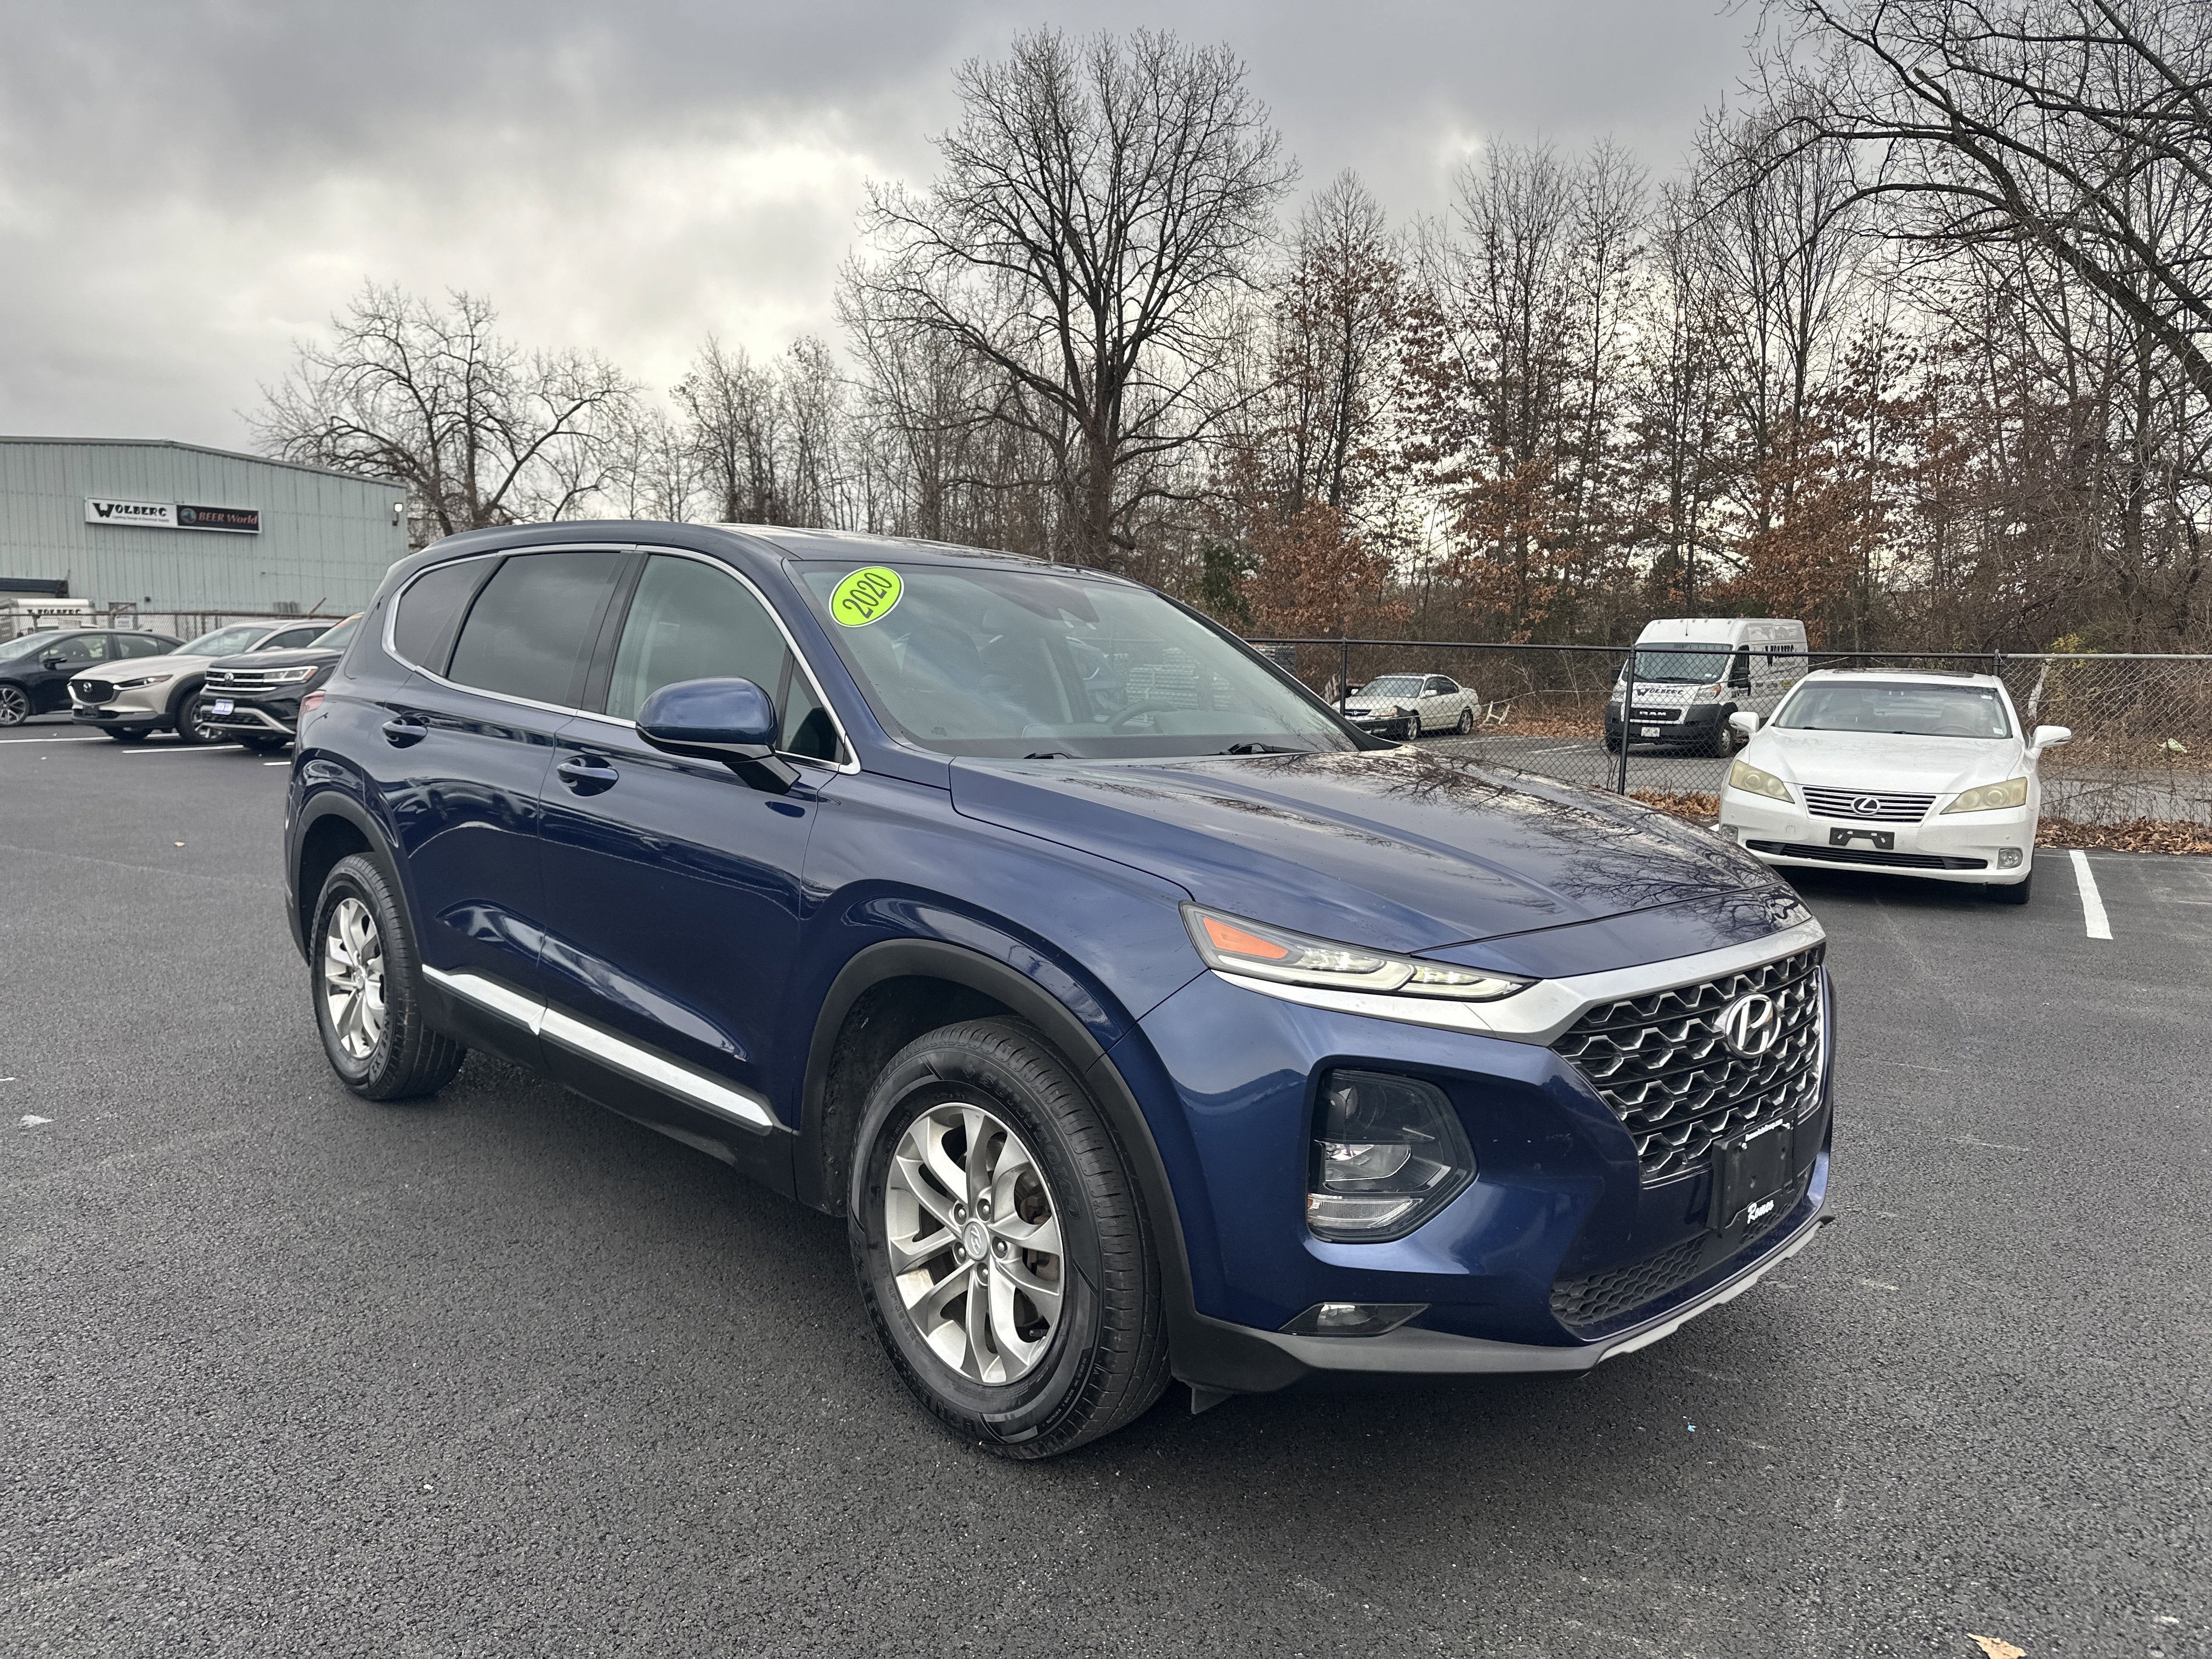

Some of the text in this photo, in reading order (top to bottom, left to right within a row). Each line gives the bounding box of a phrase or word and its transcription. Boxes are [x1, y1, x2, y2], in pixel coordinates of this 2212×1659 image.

[93, 502, 167, 518] WOLBERG
[199, 512, 258, 524] BEER World
[842, 572, 893, 619] 2020
[978, 1069, 1083, 1220] SUMITOMO
[1747, 1199, 1774, 1224] Romeo
